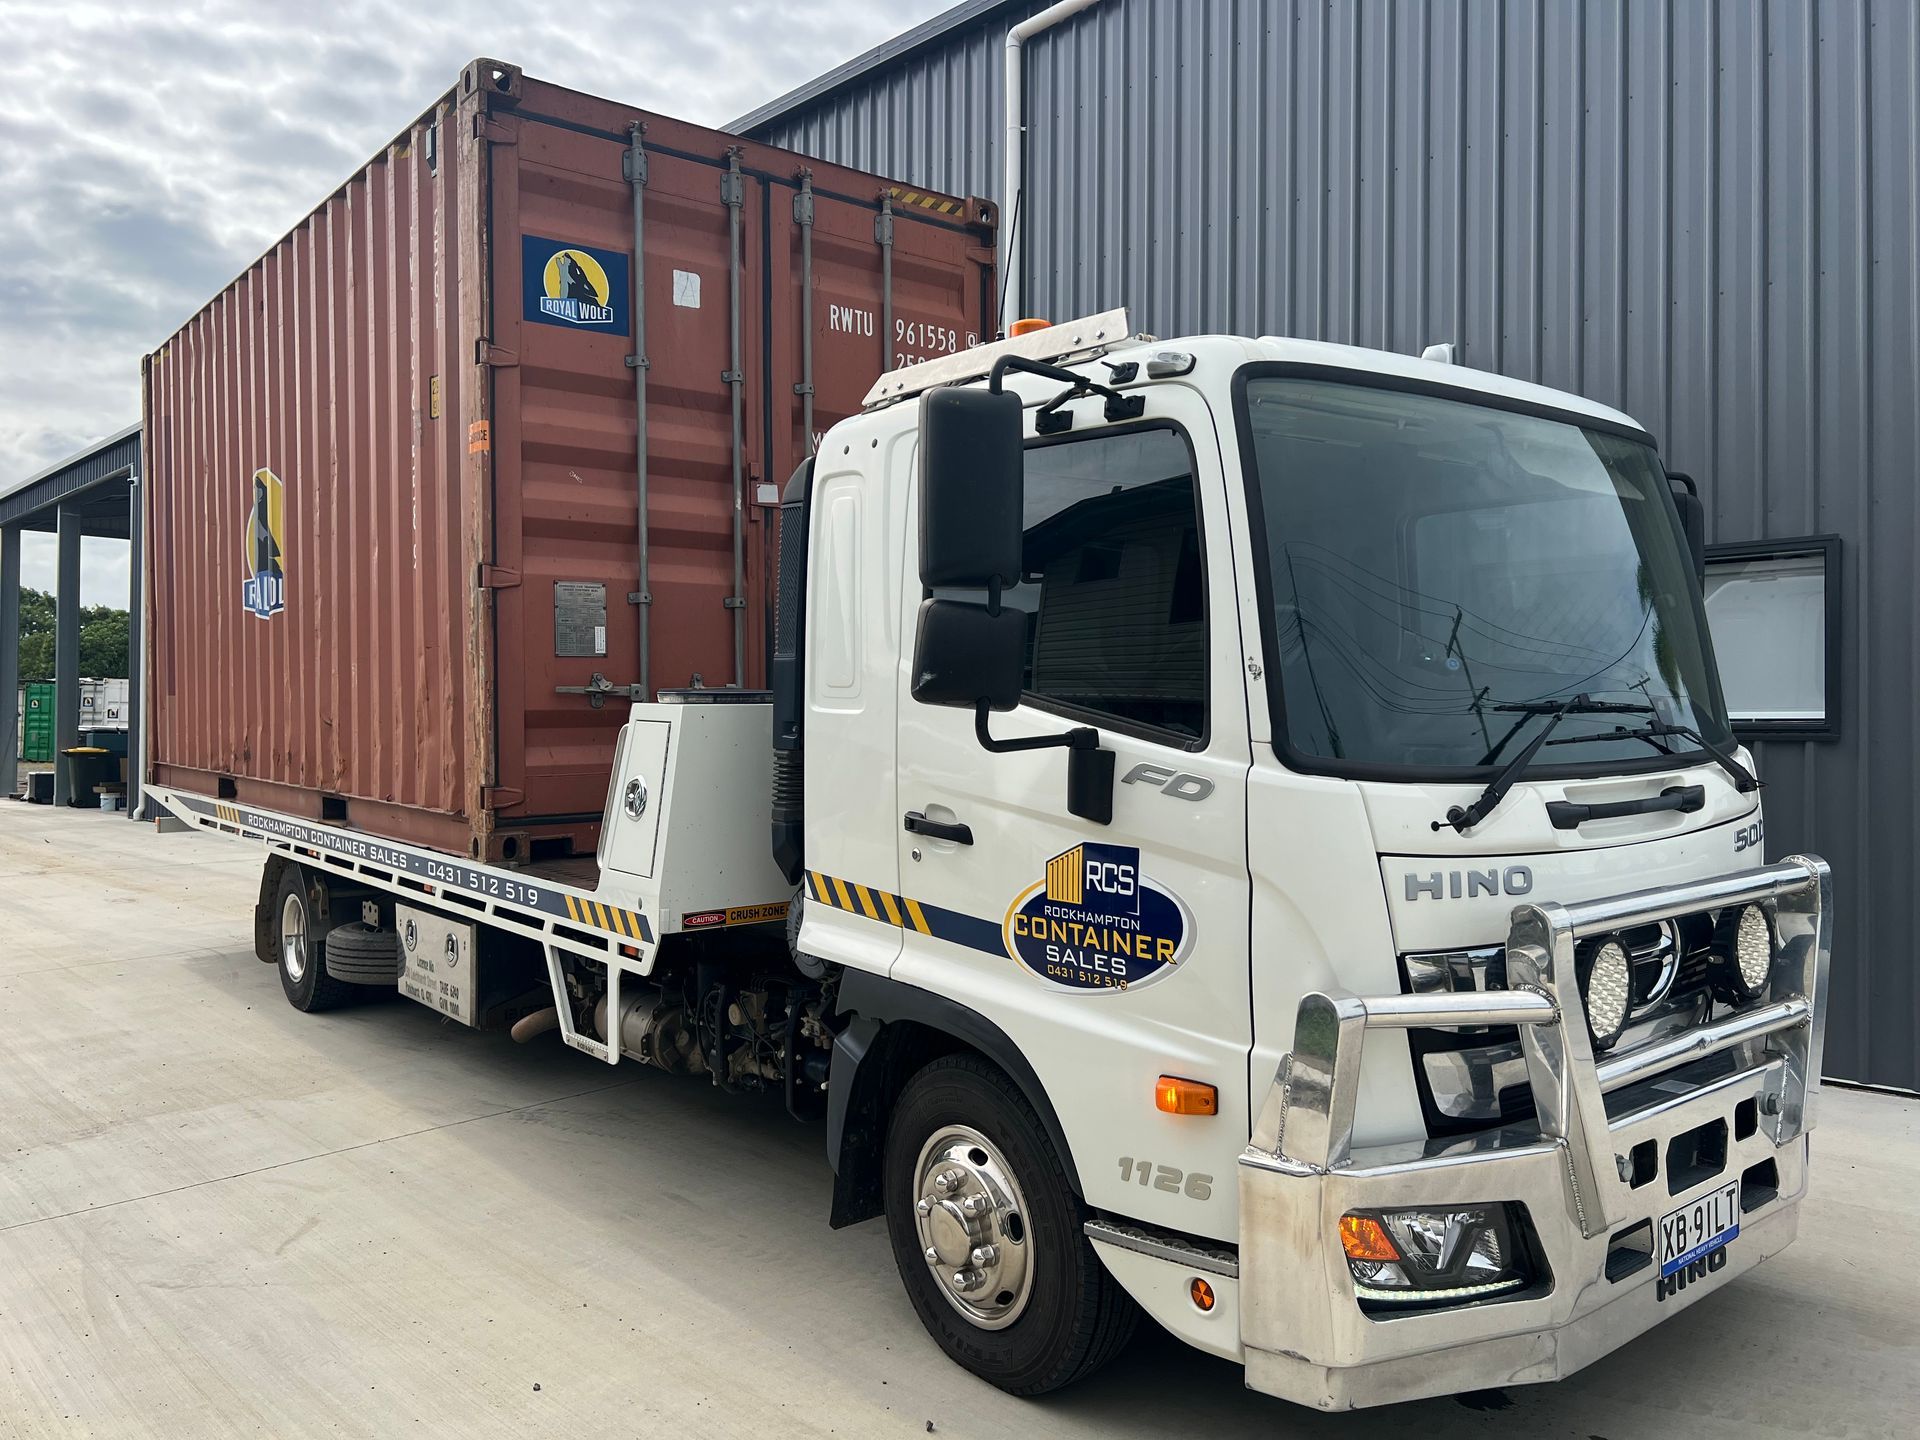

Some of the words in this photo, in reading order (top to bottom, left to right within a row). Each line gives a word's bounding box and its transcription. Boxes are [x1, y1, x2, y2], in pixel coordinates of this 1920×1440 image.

[546, 299, 577, 319] ROYAL
[578, 302, 608, 320] WOLF
[829, 304, 874, 337] RWTU
[895, 318, 956, 353] 961558
[1120, 761, 1216, 802] FD
[248, 814, 308, 841] ROCKHAMPTON
[310, 830, 366, 857] CONTAINER
[370, 846, 407, 869] SALES
[427, 861, 462, 884] 0431
[469, 873, 499, 895] 512
[505, 883, 538, 906] 519
[1085, 860, 1135, 896] RCS
[1404, 865, 1533, 902] HINO
[691, 914, 719, 924] CAUTION
[730, 908, 760, 921] CRUSH
[762, 905, 786, 918] ZONE
[1044, 905, 1140, 931] ROCKHAMPTON
[1013, 912, 1178, 966] CONTAINER
[1046, 944, 1127, 976] SALES
[1047, 964, 1074, 979] 0431
[1079, 971, 1101, 985] 512
[1104, 975, 1129, 991] 519
[1118, 1156, 1214, 1201] 1126
[1678, 1251, 1697, 1265] NATIONAL
[1695, 1244, 1709, 1255] HEAVY
[1708, 1234, 1723, 1248] VEHICLE
[1656, 1244, 1727, 1302] HINO
